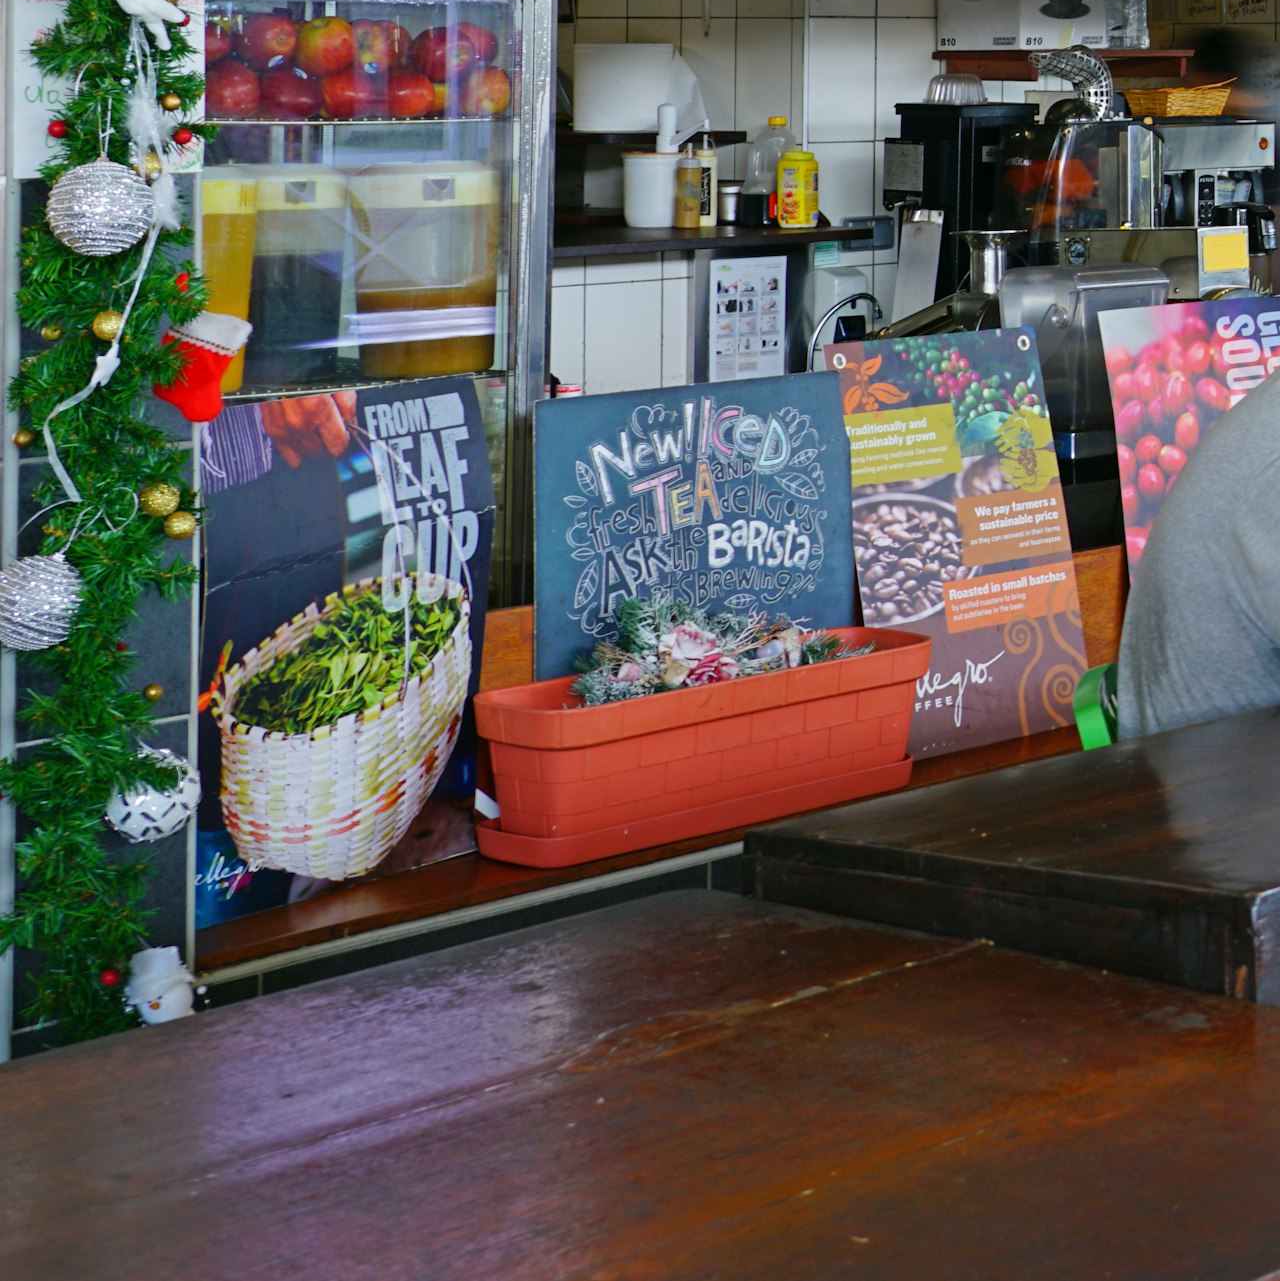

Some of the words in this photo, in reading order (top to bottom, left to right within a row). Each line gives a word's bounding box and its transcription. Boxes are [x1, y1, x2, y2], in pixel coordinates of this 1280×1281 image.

[941, 38, 956, 47] B10
[1026, 37, 1043, 46] B10
[364, 398, 428, 440] FROM
[909, 417, 927, 428] and
[851, 435, 904, 450] ustainably
[906, 432, 936, 445] grown
[370, 426, 470, 525] LEAF
[417, 498, 447, 517] TO
[975, 507, 992, 517] We
[993, 505, 1010, 516] pay
[1012, 498, 1049, 512] farmers
[1050, 498, 1056, 506] a
[979, 514, 1034, 531] sustainable
[1035, 510, 1059, 524] price
[382, 510, 479, 613] CUP
[949, 583, 990, 601] Roasted
[991, 582, 1001, 593] in
[1002, 575, 1028, 589] small
[1029, 571, 1067, 586] batches
